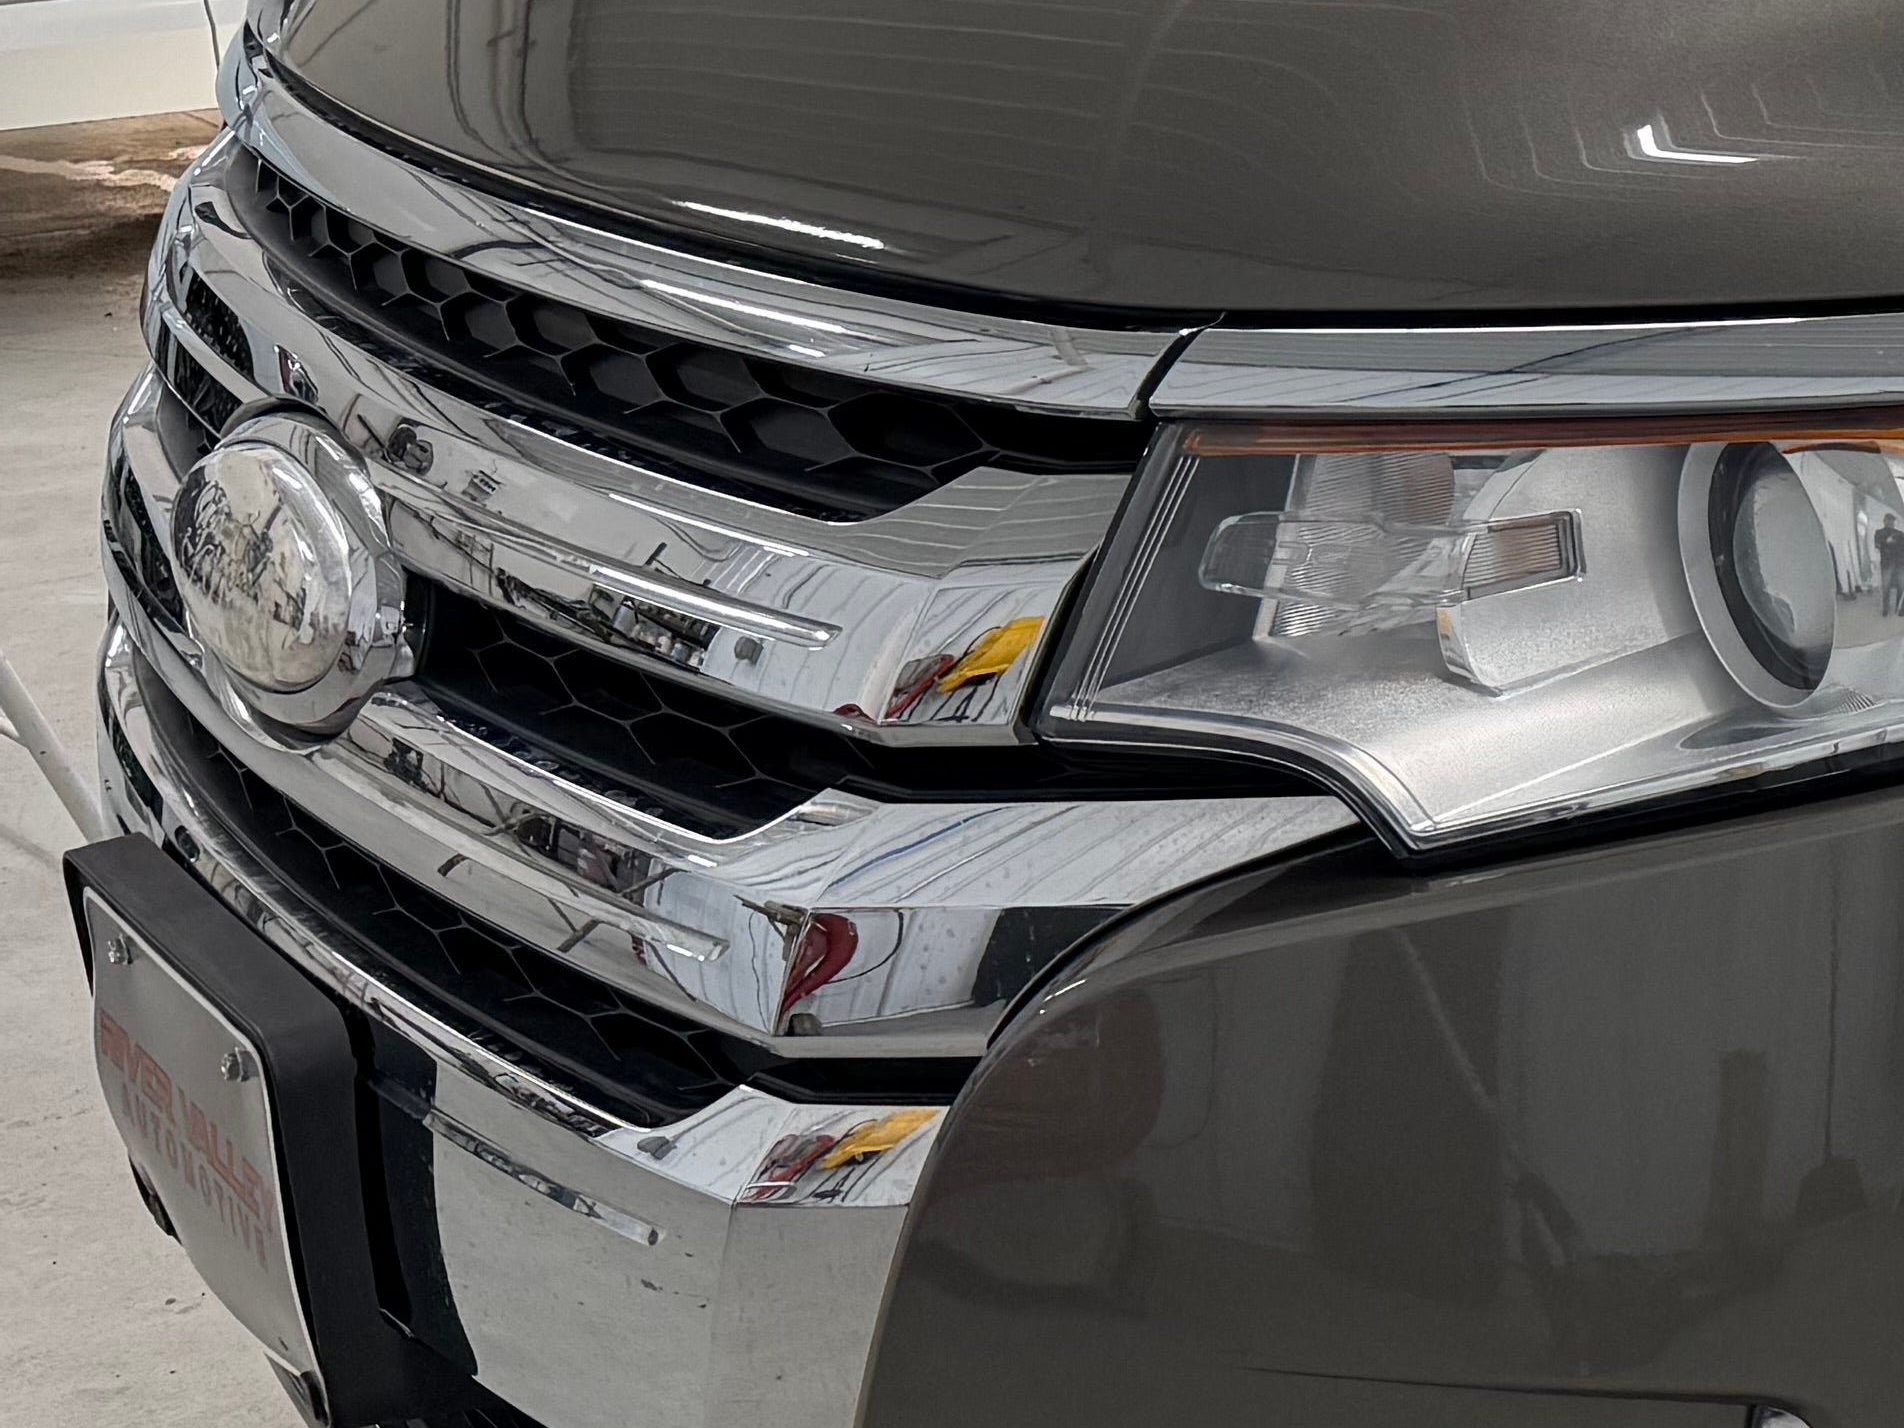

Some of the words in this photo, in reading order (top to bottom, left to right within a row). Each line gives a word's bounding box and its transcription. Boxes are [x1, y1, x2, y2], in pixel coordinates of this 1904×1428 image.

[99, 1008, 176, 1126] RIVER
[176, 1083, 274, 1232] VALLEY
[121, 1080, 269, 1273] AUTOMOTIVE
